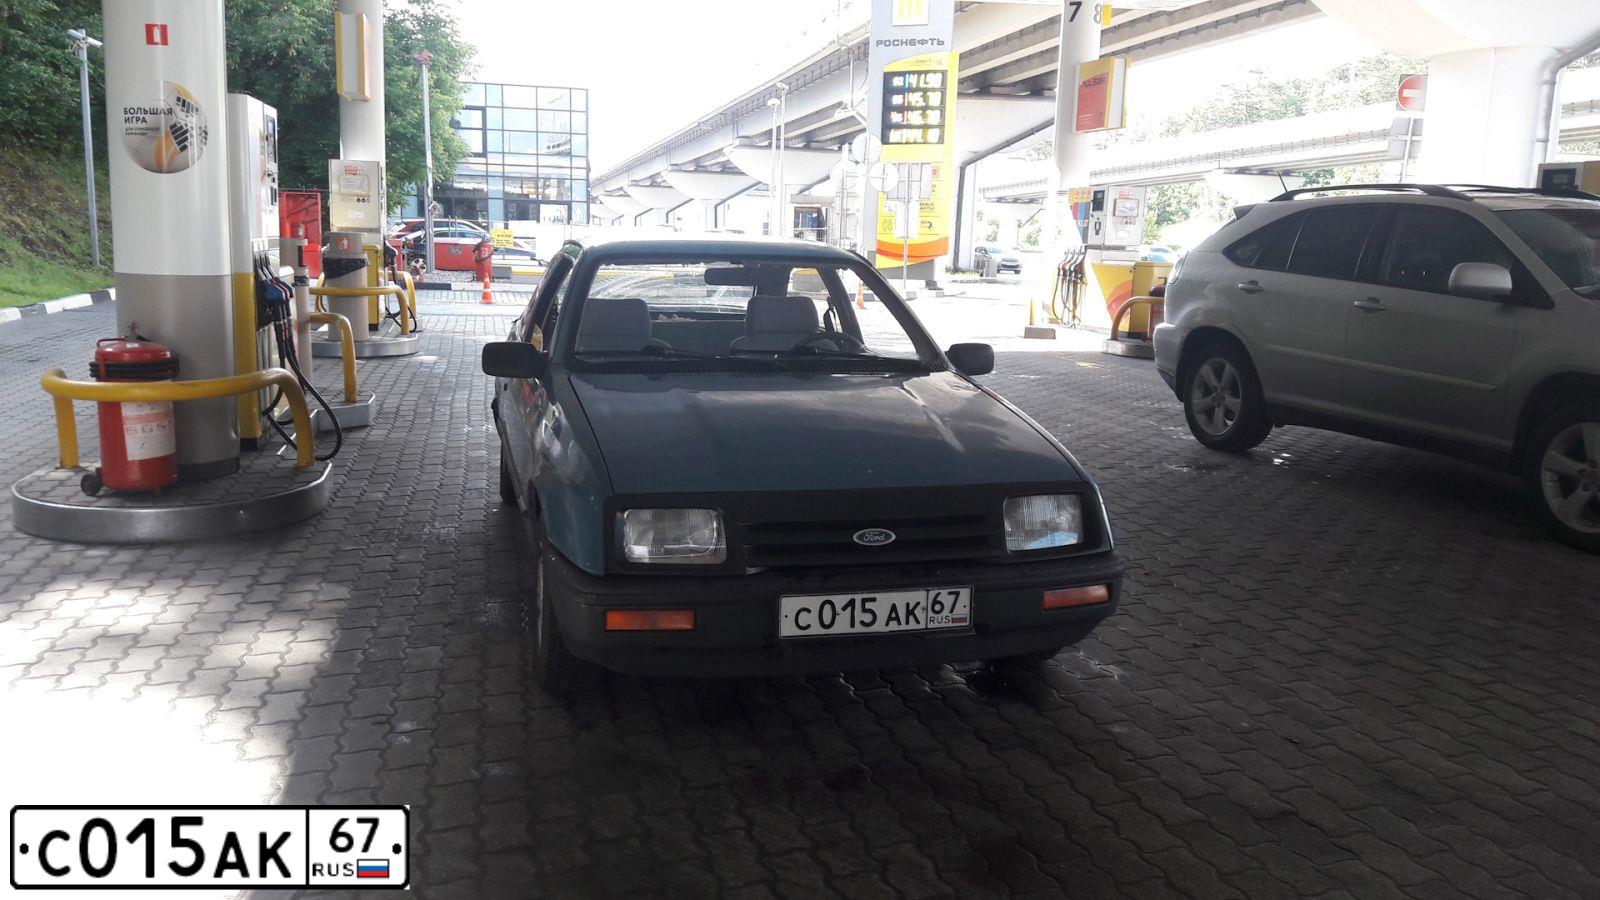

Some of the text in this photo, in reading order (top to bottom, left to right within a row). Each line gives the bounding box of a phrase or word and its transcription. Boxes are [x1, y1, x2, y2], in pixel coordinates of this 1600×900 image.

[1069, 1, 1082, 22] 7
[876, 38, 945, 47] РОСНЕФТЬ
[123, 107, 173, 116] БОЛЬШАЯ
[124, 116, 148, 124] ИГРА
[863, 531, 886, 541] Ford
[794, 591, 960, 630] C015AK 67
[929, 615, 951, 625] RUS
